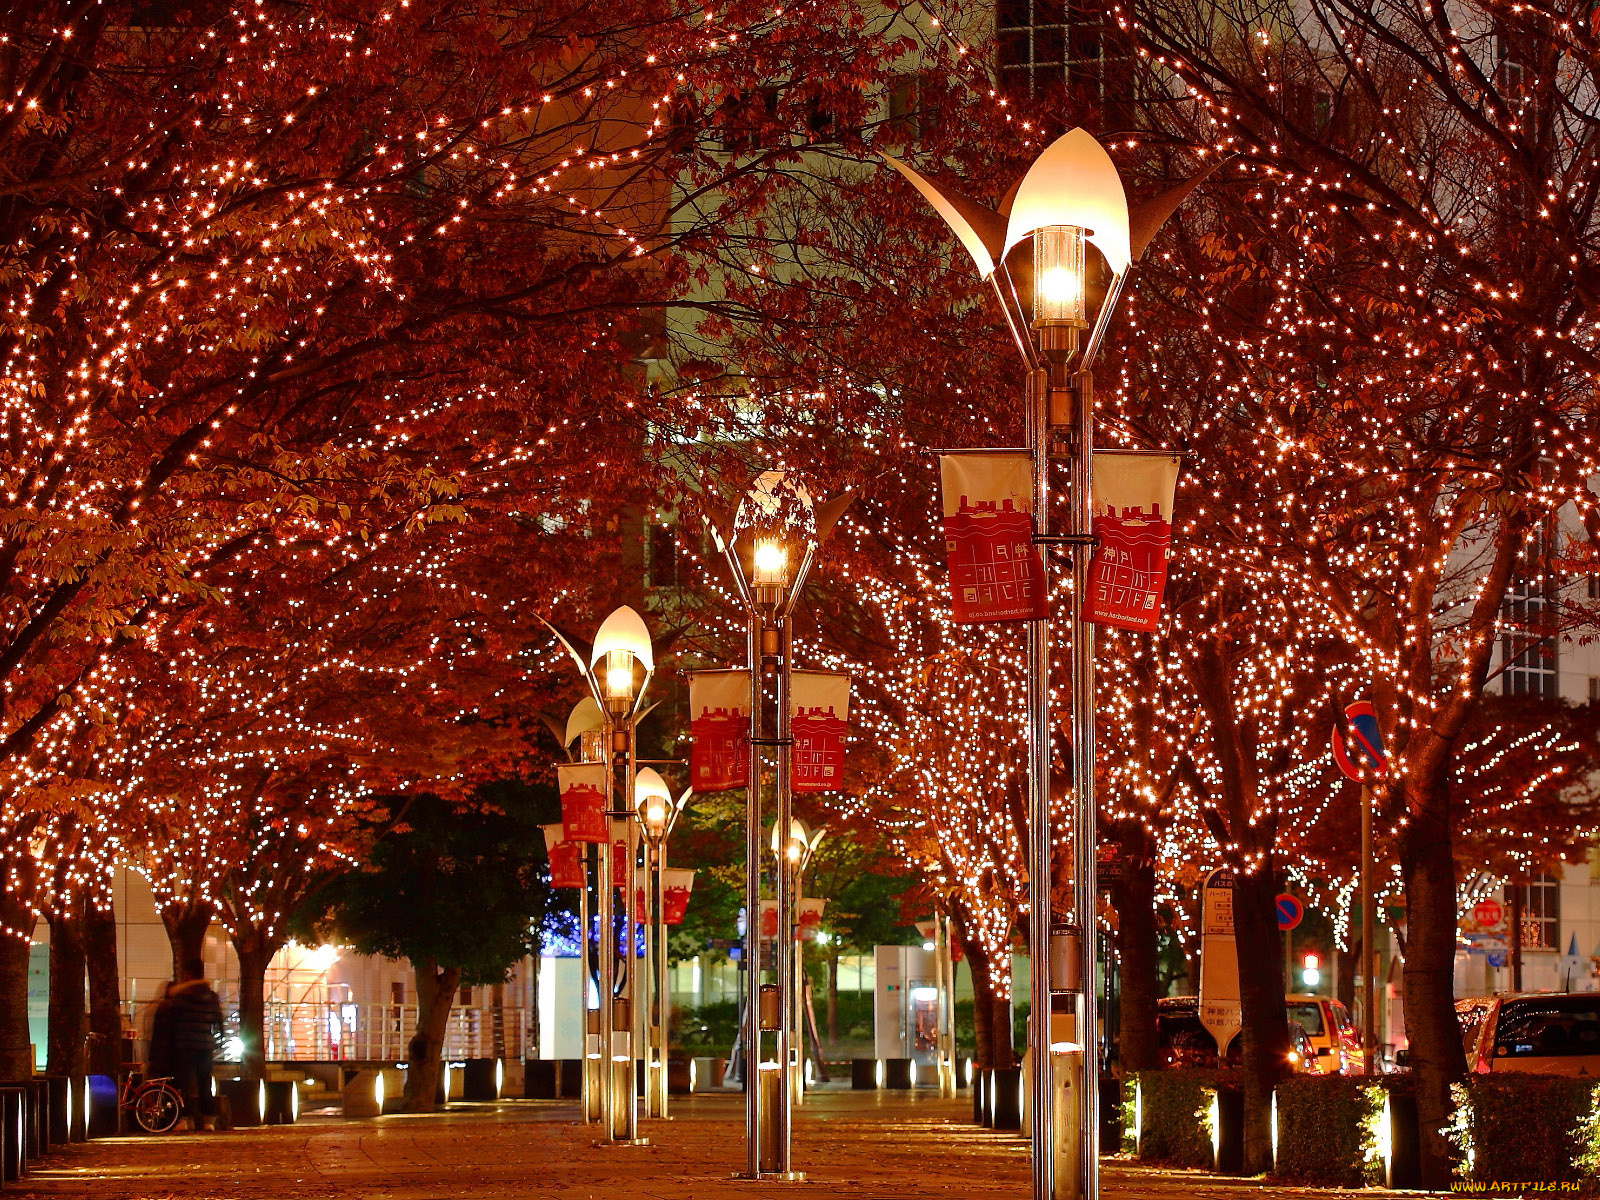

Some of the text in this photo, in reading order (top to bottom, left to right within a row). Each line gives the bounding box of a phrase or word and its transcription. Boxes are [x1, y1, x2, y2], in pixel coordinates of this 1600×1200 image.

[1103, 546, 1129, 564] 神戸
[1101, 565, 1158, 588] ハーバー
[1098, 586, 1142, 607] ランド
